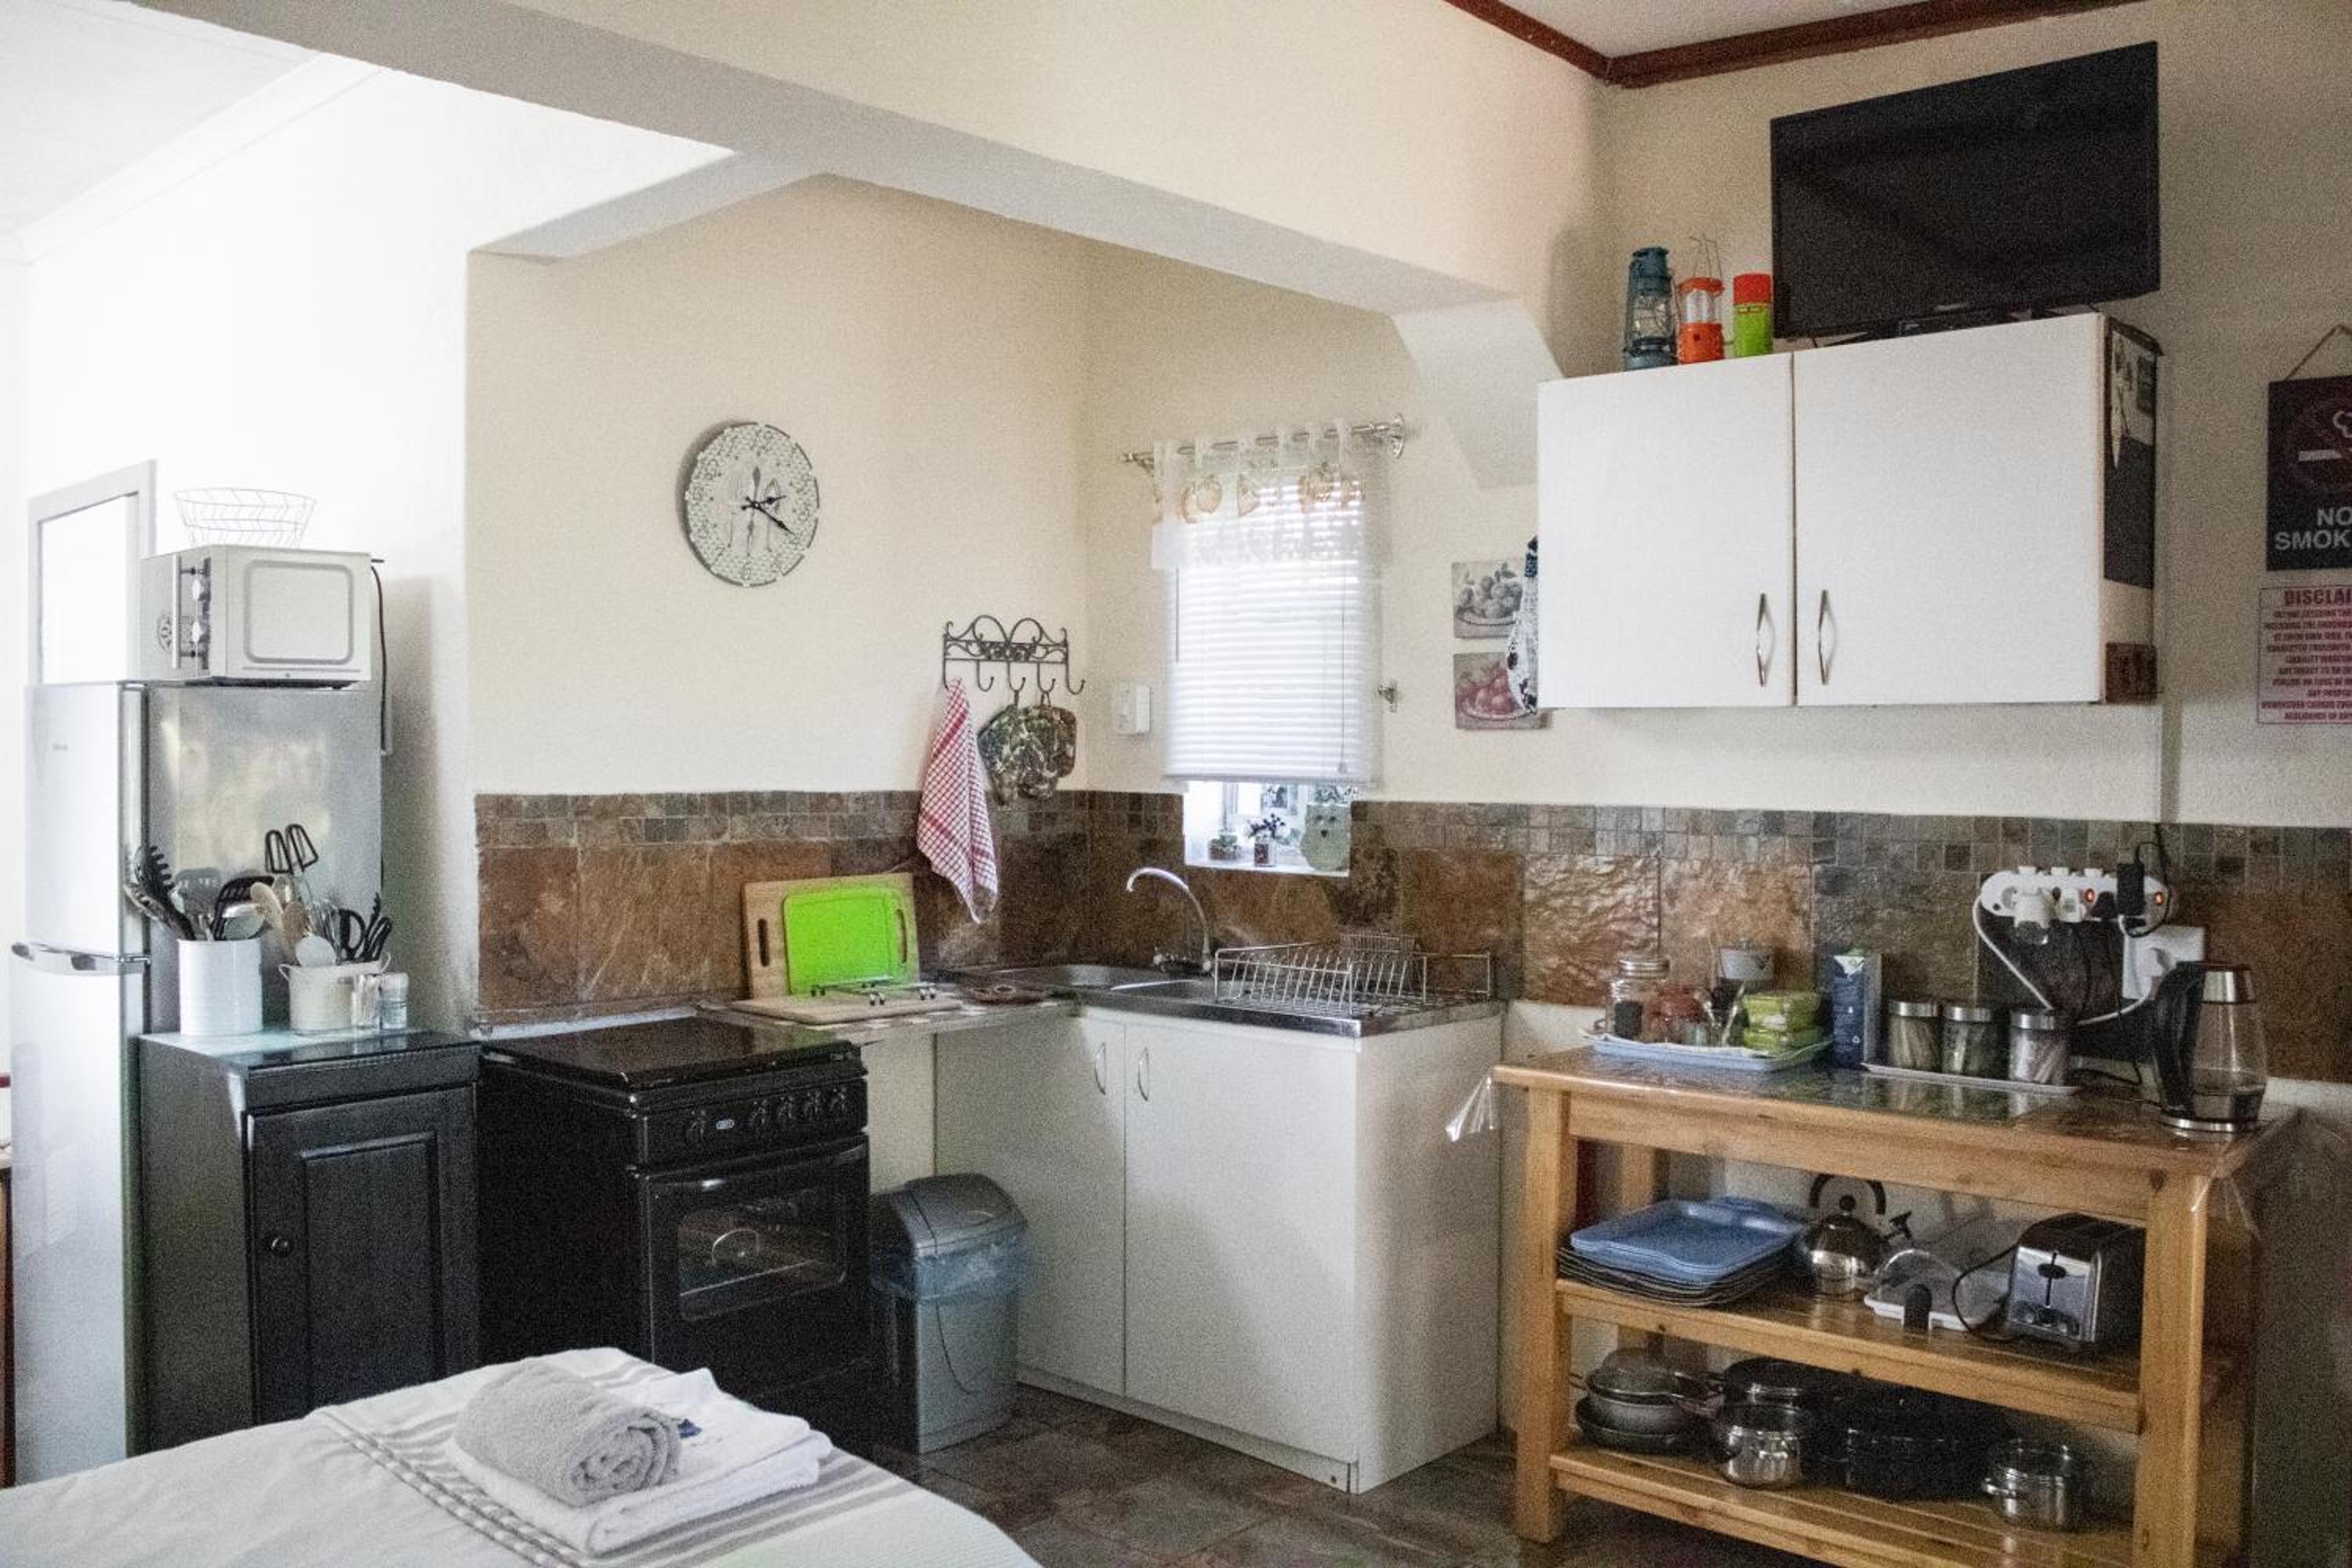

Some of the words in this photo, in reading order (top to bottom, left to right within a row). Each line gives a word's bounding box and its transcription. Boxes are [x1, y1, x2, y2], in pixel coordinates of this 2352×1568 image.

[2317, 506, 2352, 526] NO
[2274, 529, 2351, 550] SMOK
[2283, 588, 2351, 606] DISCLAI
